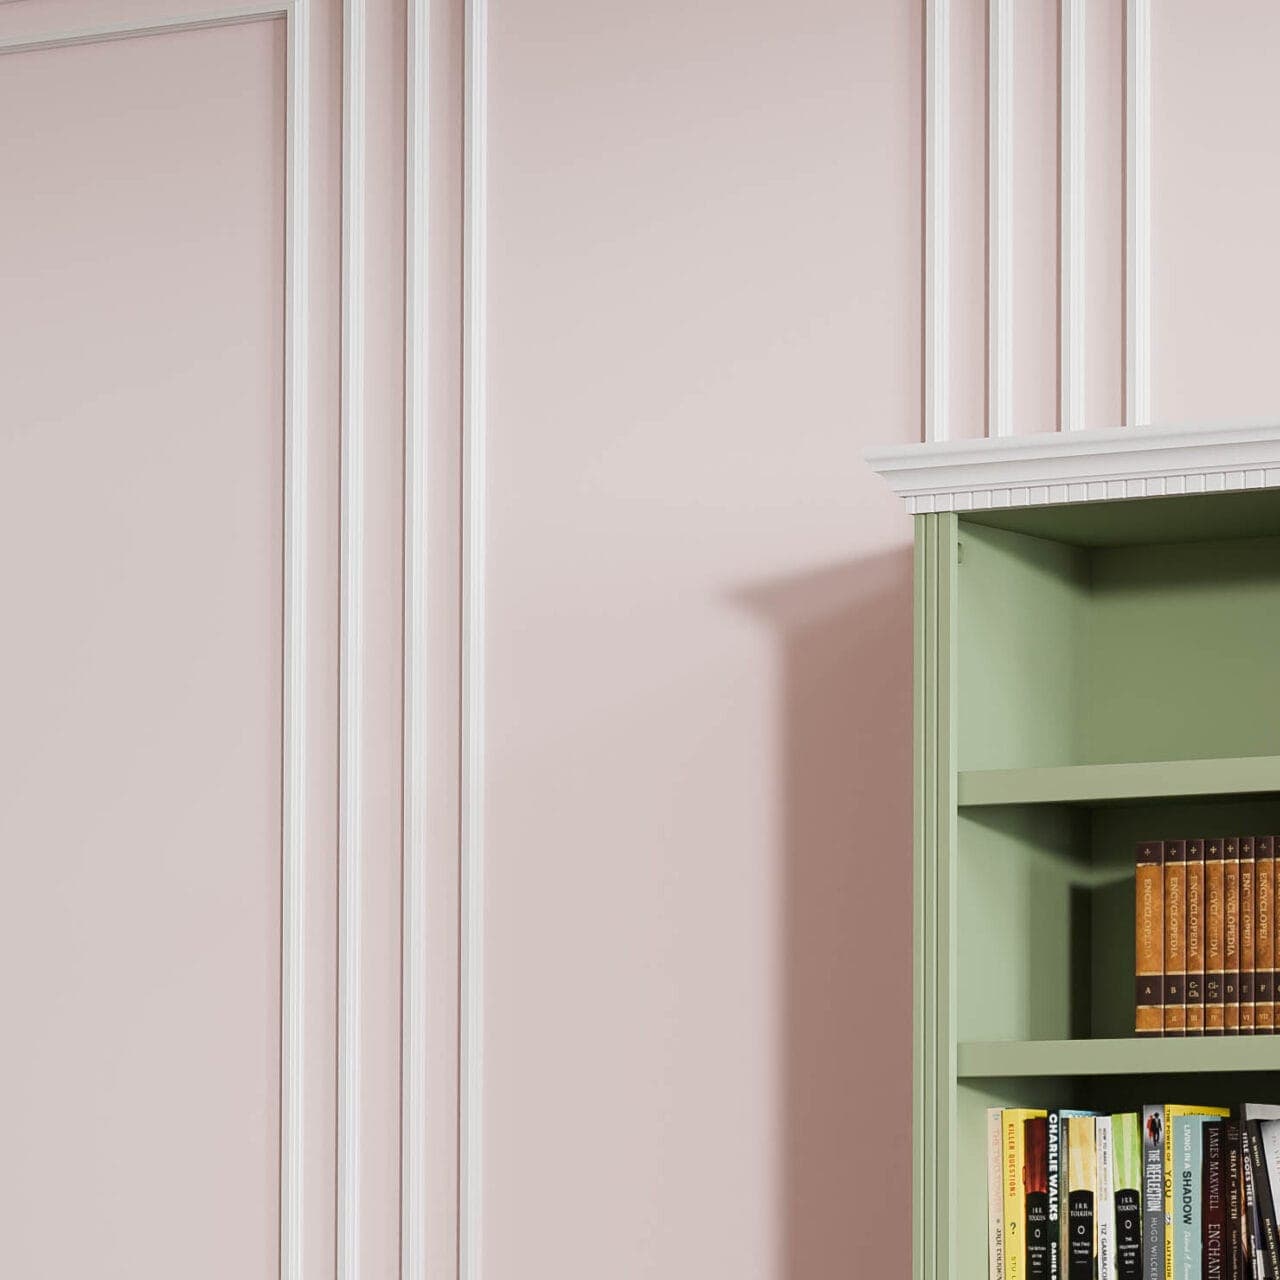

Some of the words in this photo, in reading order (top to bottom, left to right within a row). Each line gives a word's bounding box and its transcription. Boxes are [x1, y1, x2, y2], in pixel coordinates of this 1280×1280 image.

[1170, 877, 1178, 959] ENCYCLOPEDIA
[1190, 875, 1198, 957] ENCYCLOPEDIA
[1048, 1113, 1058, 1172] CHARLIE
[1148, 1150, 1160, 1162] THE
[1166, 1153, 1171, 1161] OF
[1184, 1153, 1191, 1161] IN
[1208, 1127, 1219, 1159] JAMES
[1008, 1154, 1016, 1197] QUESTIONS
[1048, 1174, 1058, 1221] WALKS
[1146, 1164, 1162, 1212] REFLECTION
[1164, 1170, 1172, 1198] YOU
[1182, 1170, 1192, 1225] SHADOW
[1209, 1161, 1219, 1211] MAXWELL
[1150, 1217, 1158, 1243] HUGO
